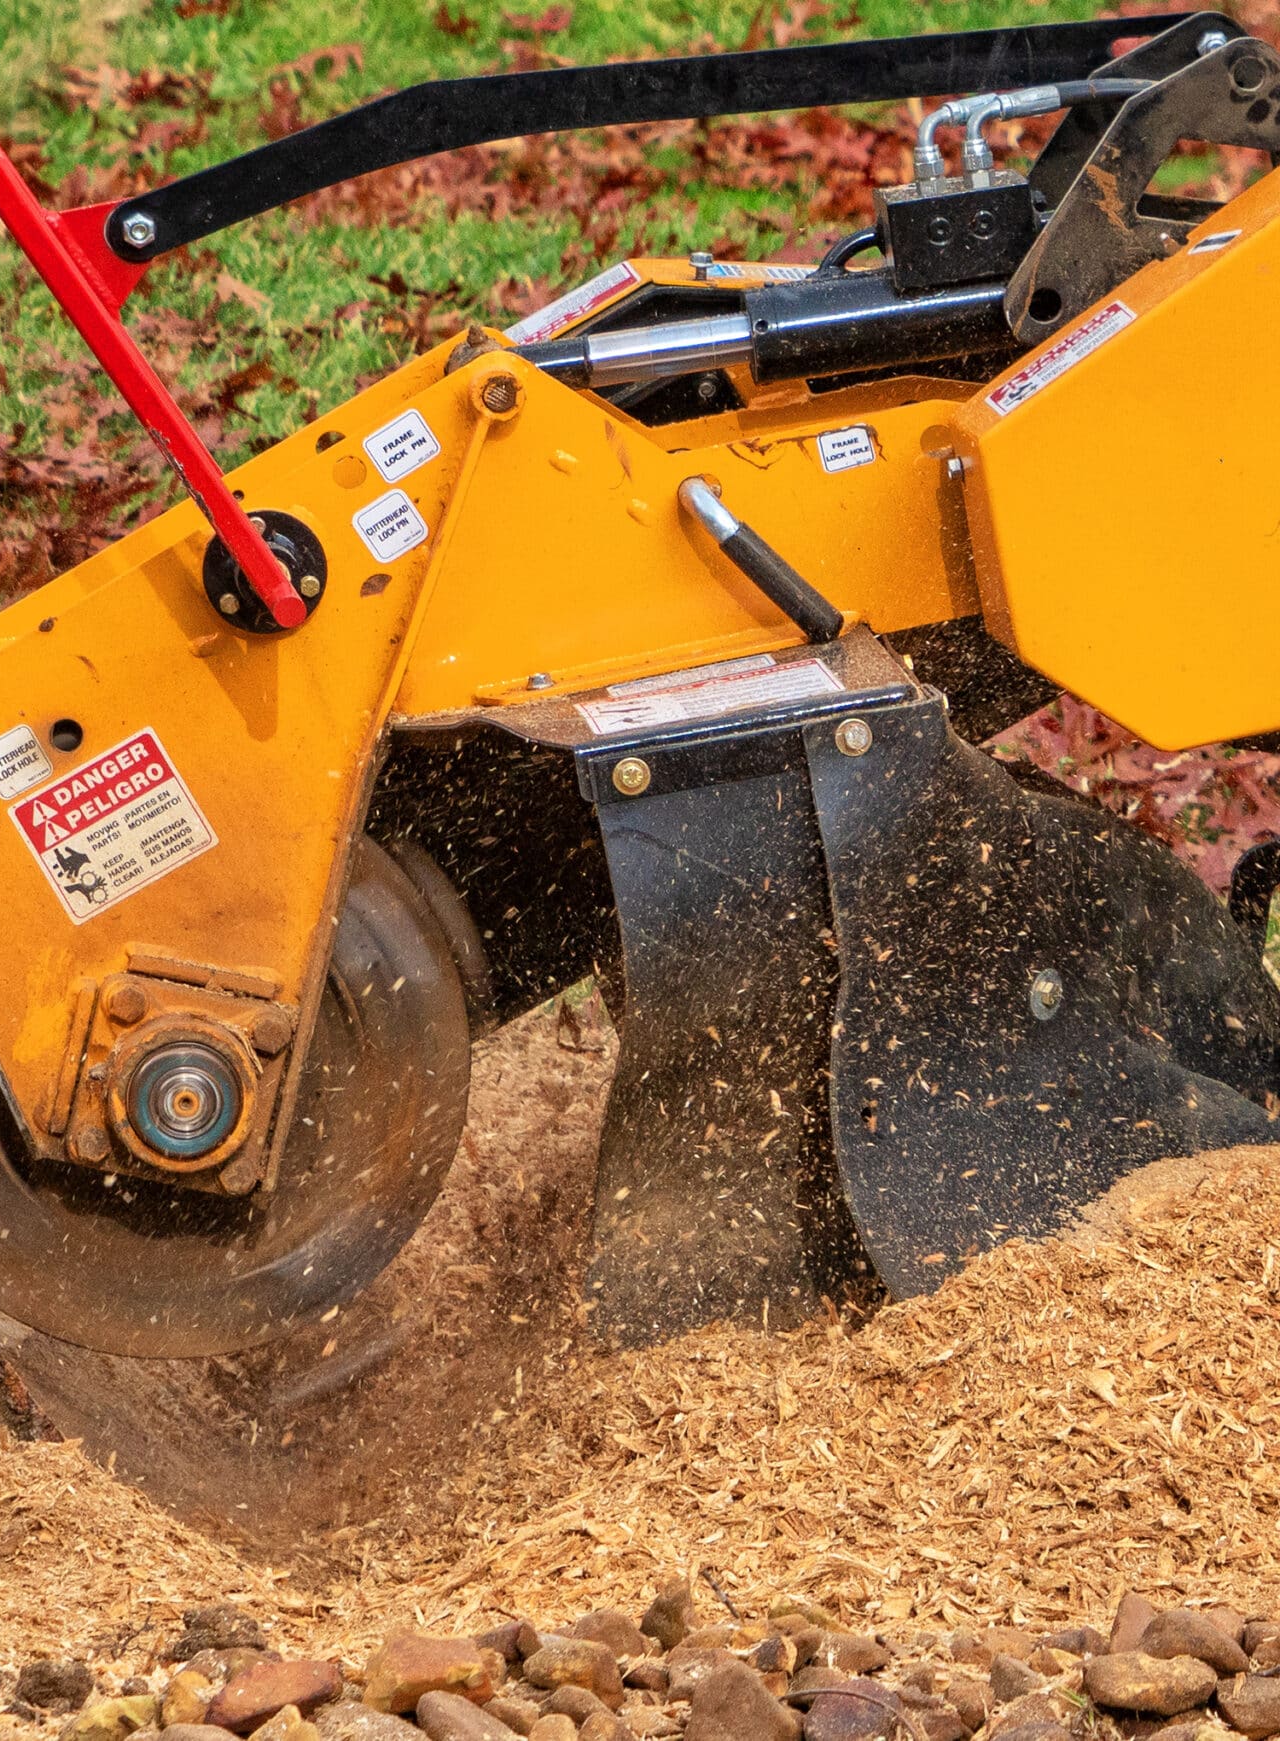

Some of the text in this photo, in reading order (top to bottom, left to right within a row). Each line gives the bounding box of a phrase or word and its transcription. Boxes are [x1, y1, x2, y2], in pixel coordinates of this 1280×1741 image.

[382, 429, 415, 453] FRAME
[384, 449, 408, 467] LOCK
[411, 436, 427, 451] PIN
[826, 452, 846, 462] LOCK
[365, 504, 409, 537] CUTTERHEAD
[377, 525, 397, 543] LOCK
[395, 517, 410, 532] PIN
[17, 751, 40, 770] HOLE
[53, 742, 149, 807] DANGER
[65, 762, 164, 829] PELIGRO
[158, 790, 171, 802] EN
[128, 795, 182, 831] MOVIMIENTO!
[86, 820, 119, 843] MOVING
[92, 830, 122, 851] PARTS!
[140, 817, 187, 850] ¡MANTENGA
[144, 843, 161, 858] SUS
[162, 826, 192, 848] MANOS
[102, 853, 124, 870] KEEP
[149, 837, 195, 866] ALEJADAS!
[108, 857, 137, 879] HANDS
[113, 866, 144, 887] CLEAR!
